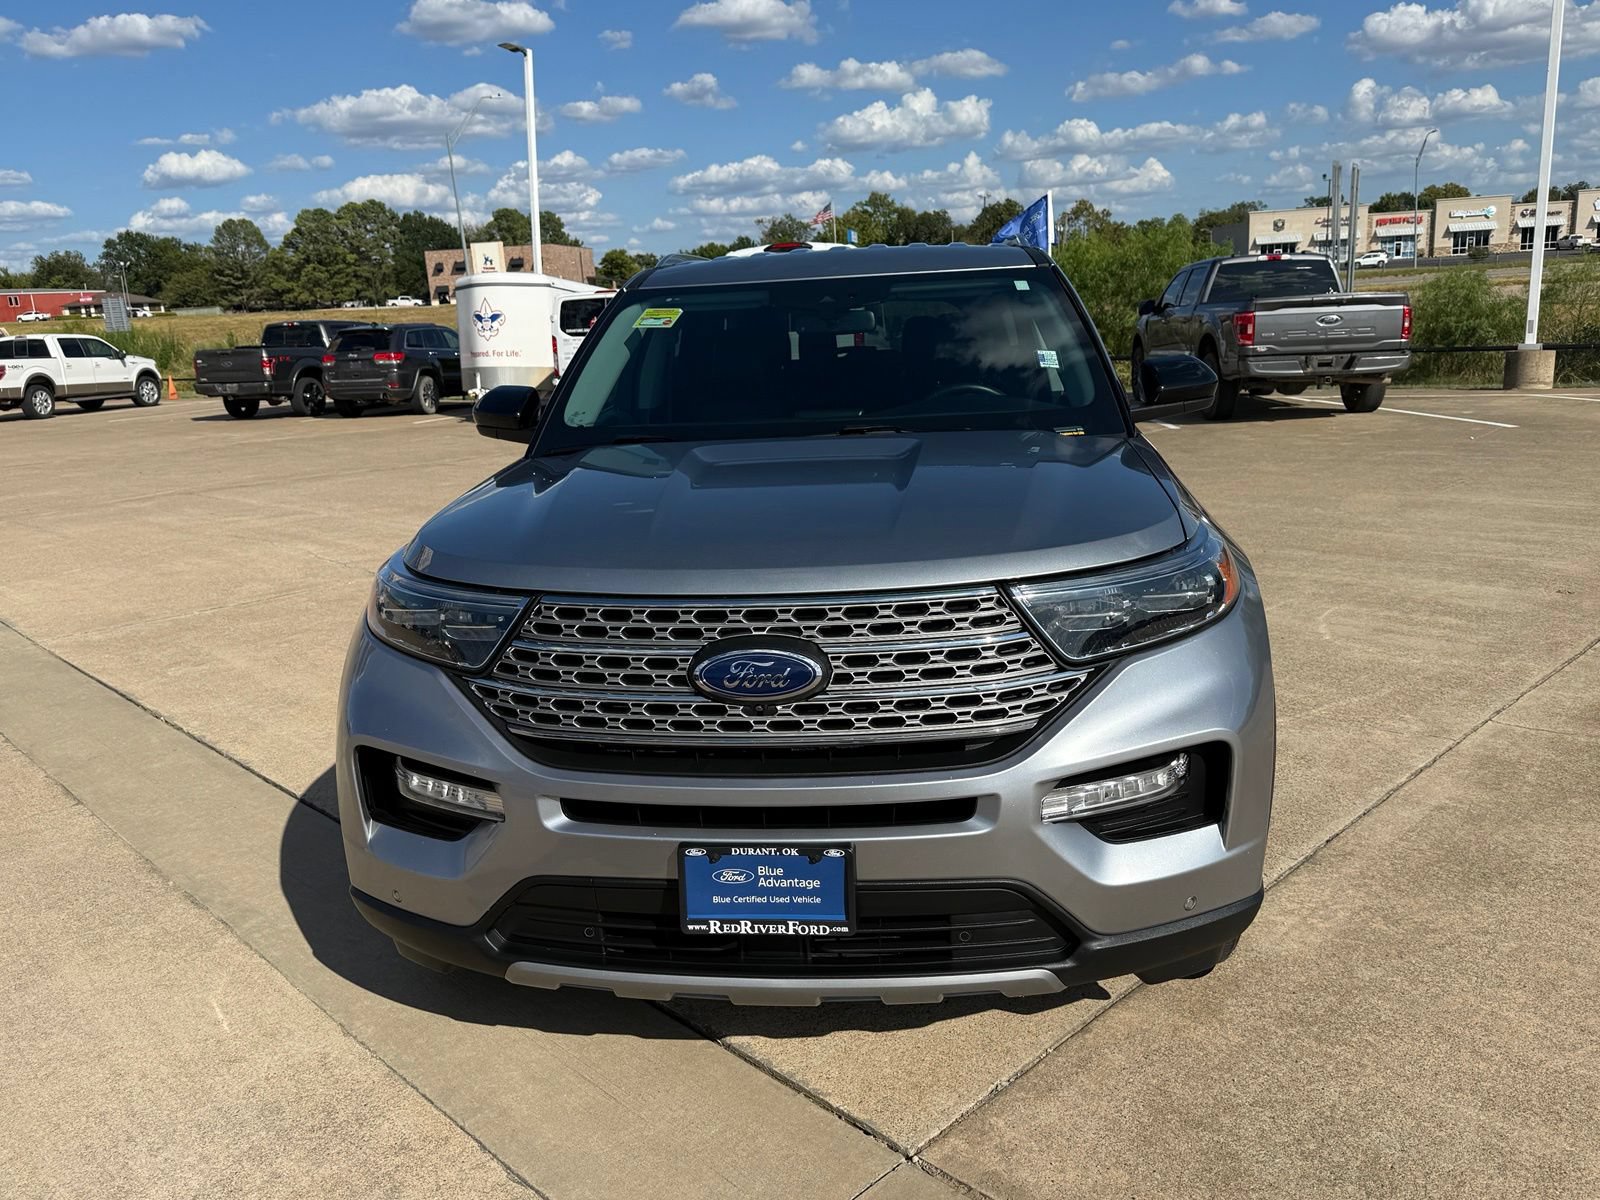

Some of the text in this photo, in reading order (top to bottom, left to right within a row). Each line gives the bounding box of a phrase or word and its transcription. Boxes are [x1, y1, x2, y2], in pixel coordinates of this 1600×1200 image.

[492, 349, 503, 358] For
[723, 660, 791, 688] Ford
[731, 847, 799, 856] DURANT, OK
[757, 865, 784, 876] Blue
[719, 871, 748, 882] Ford
[757, 877, 821, 889] Advantage
[712, 895, 822, 904] Blue Certified Used Vehicle
